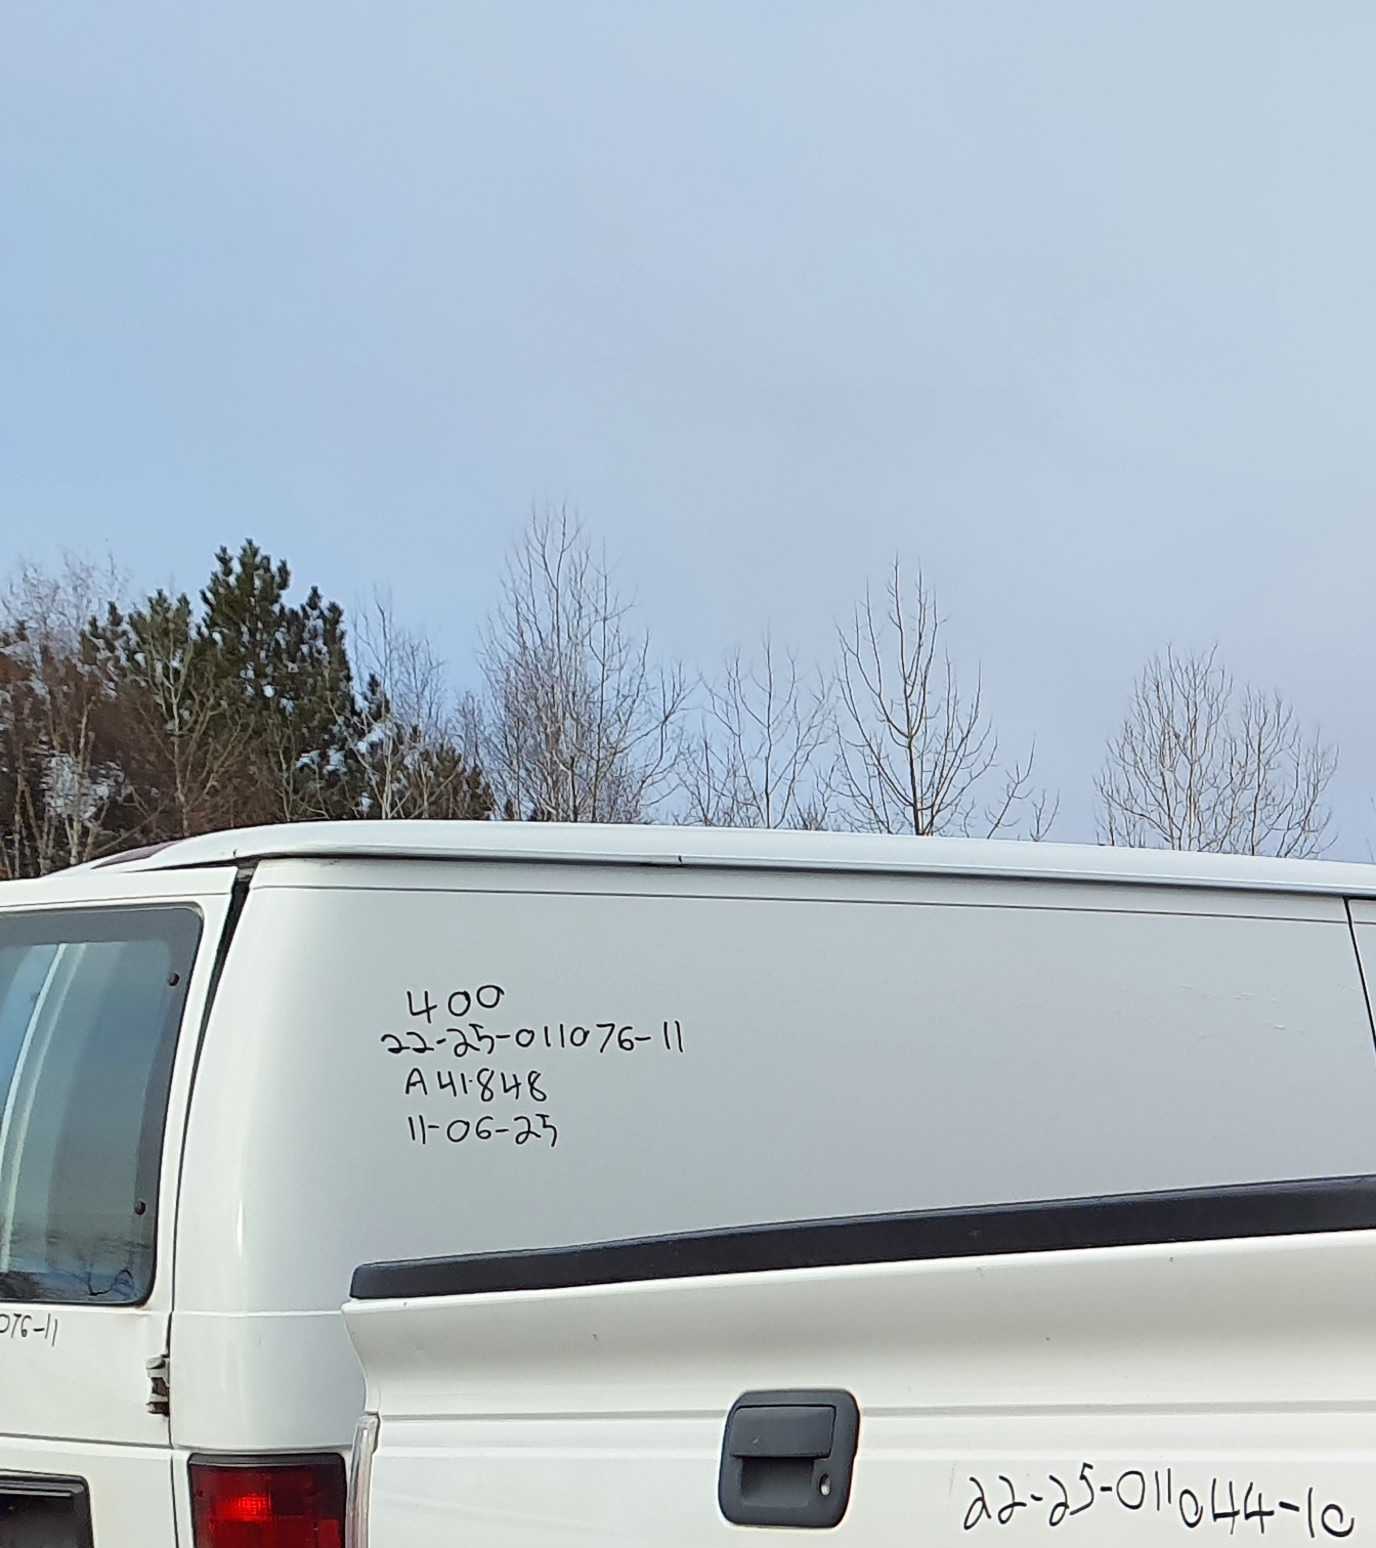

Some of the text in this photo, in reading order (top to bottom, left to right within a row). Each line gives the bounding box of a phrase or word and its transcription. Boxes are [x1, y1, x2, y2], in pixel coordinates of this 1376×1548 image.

[406, 984, 505, 1025] 400
[379, 1019, 685, 1058] 22-25-011076-11
[407, 1113, 558, 1149] 11-06-25
[962, 1461, 1357, 1540] 22-25-011044-10
